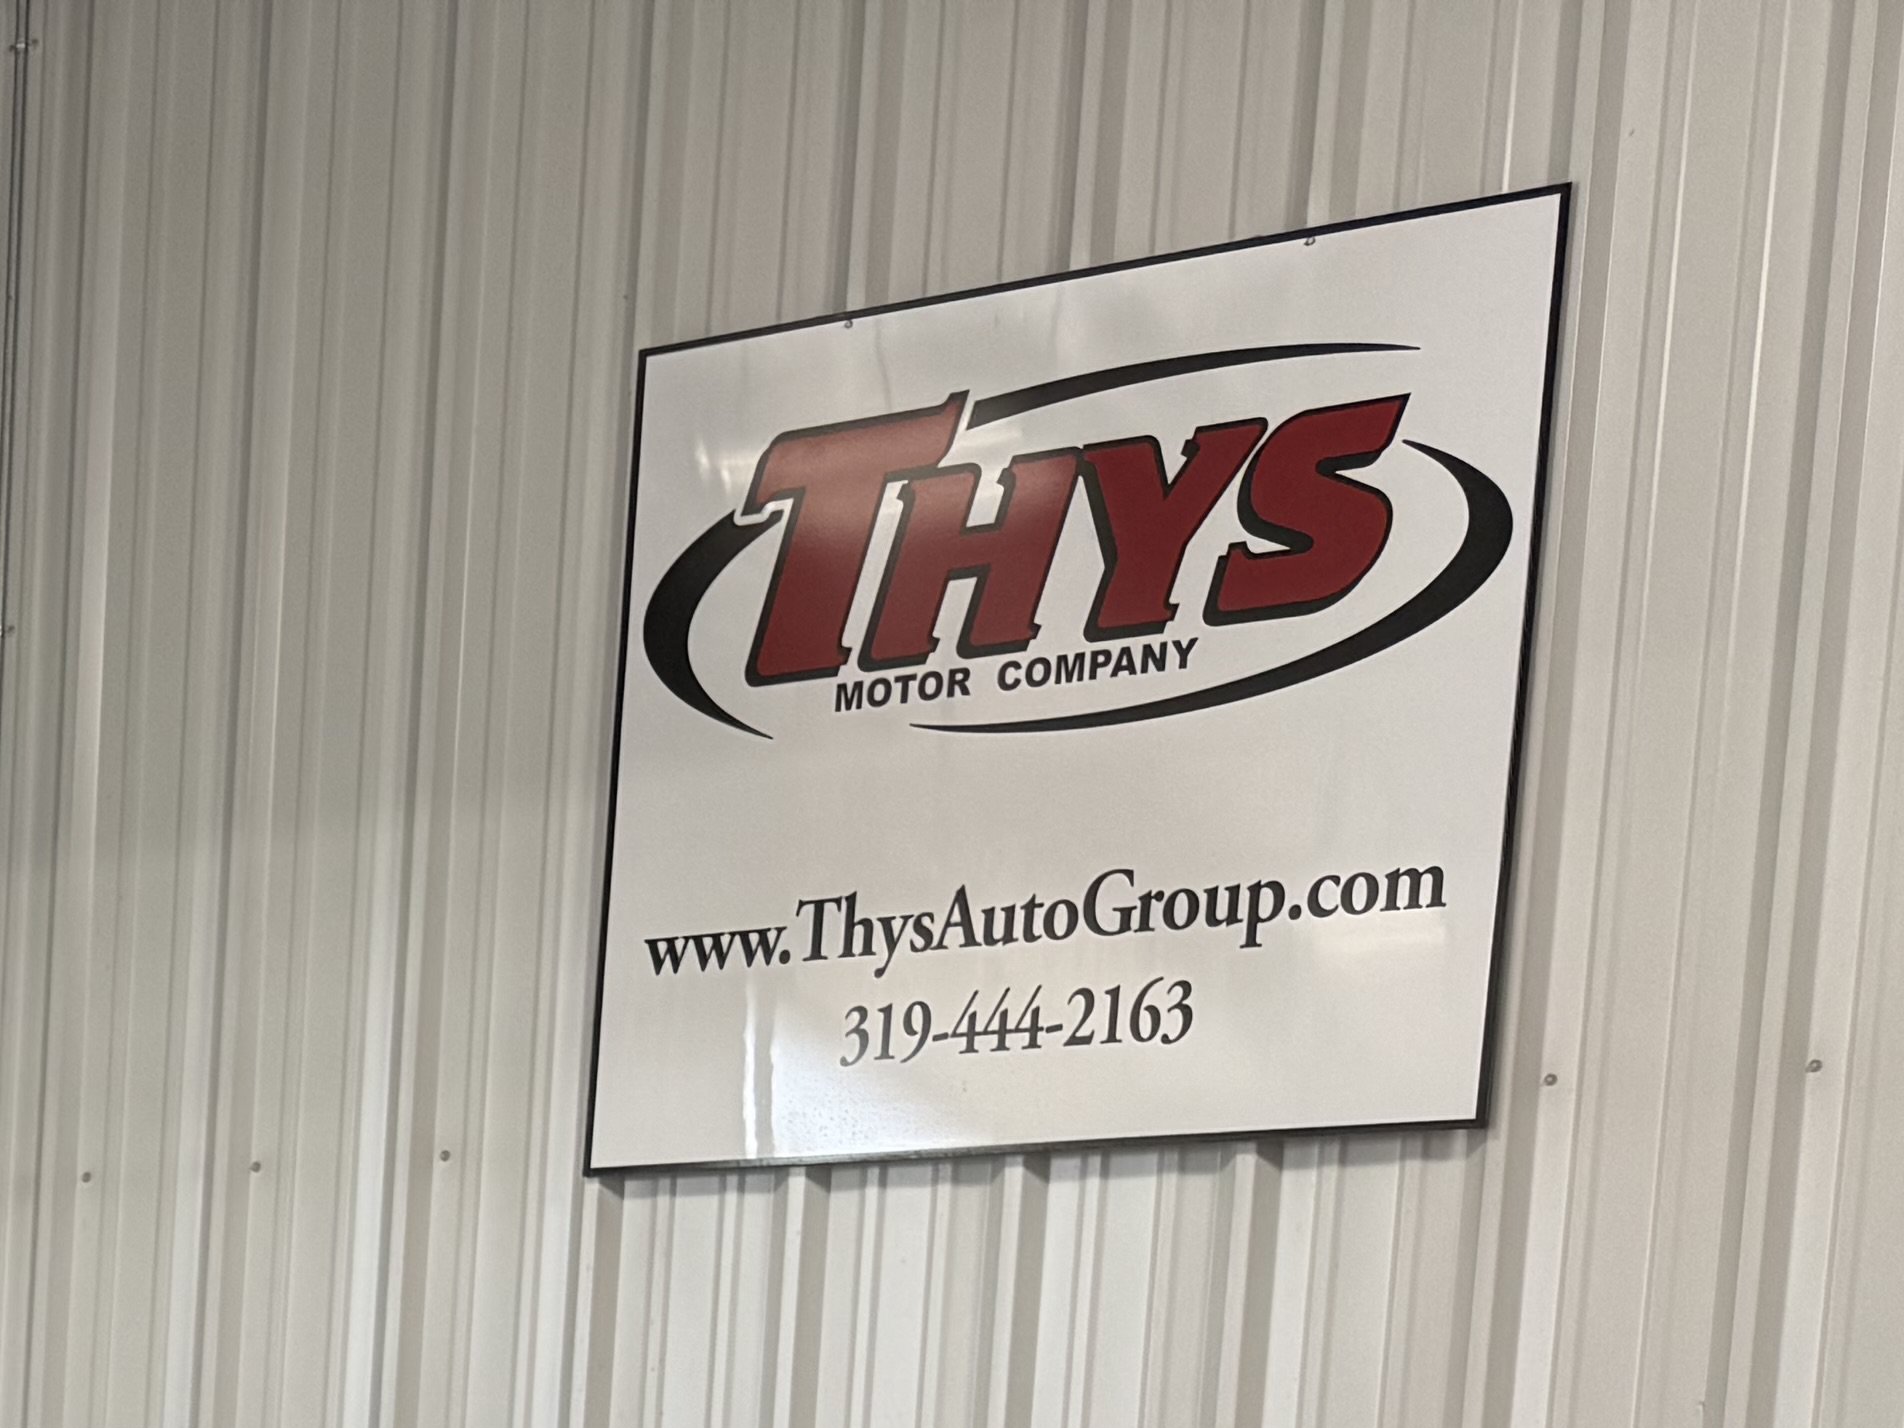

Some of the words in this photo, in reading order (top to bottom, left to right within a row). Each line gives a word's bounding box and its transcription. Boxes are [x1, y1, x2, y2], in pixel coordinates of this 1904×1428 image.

[834, 666, 972, 714] MOTOR
[996, 638, 1199, 693] COMPANY
[644, 864, 1447, 978] www.ThysAutoGroup.com
[838, 976, 1195, 1068] 319-444-2163
